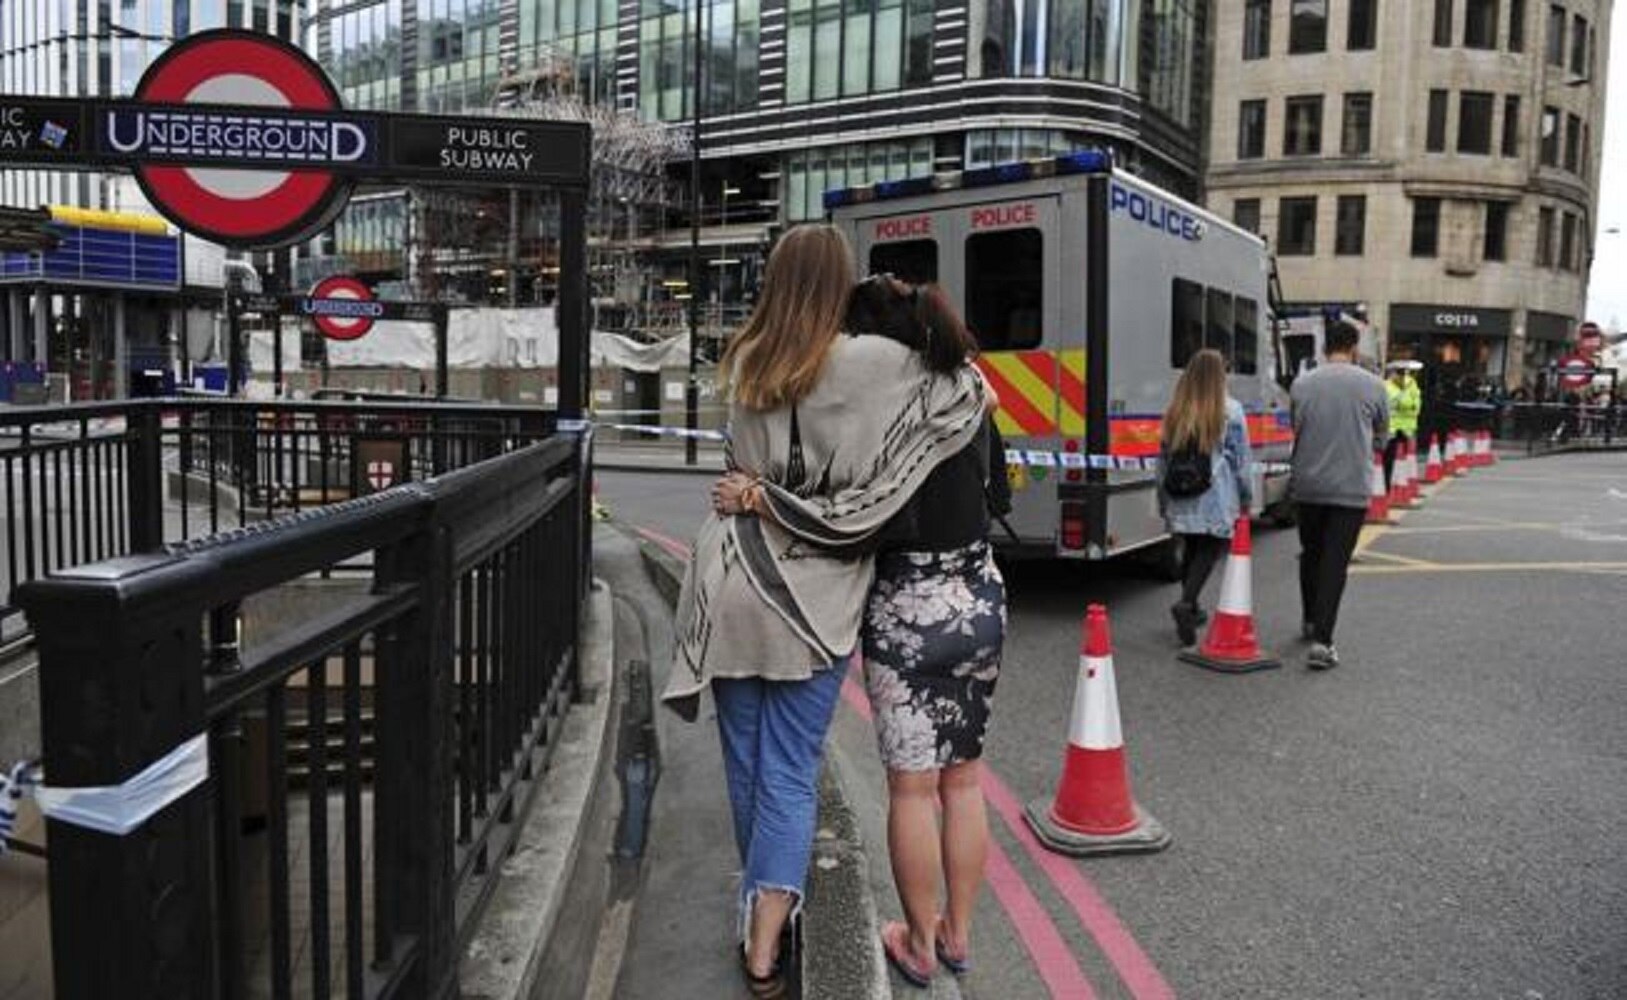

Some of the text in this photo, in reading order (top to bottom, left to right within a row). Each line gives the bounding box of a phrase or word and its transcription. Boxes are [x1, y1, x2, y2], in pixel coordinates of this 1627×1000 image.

[108, 111, 366, 161] UNDERGROUND
[448, 127, 528, 149] PUBLIC
[440, 149, 534, 171] SUBWAY
[971, 204, 1036, 229] POLICE
[1111, 183, 1195, 241] POLICE
[876, 216, 932, 239] POLICE
